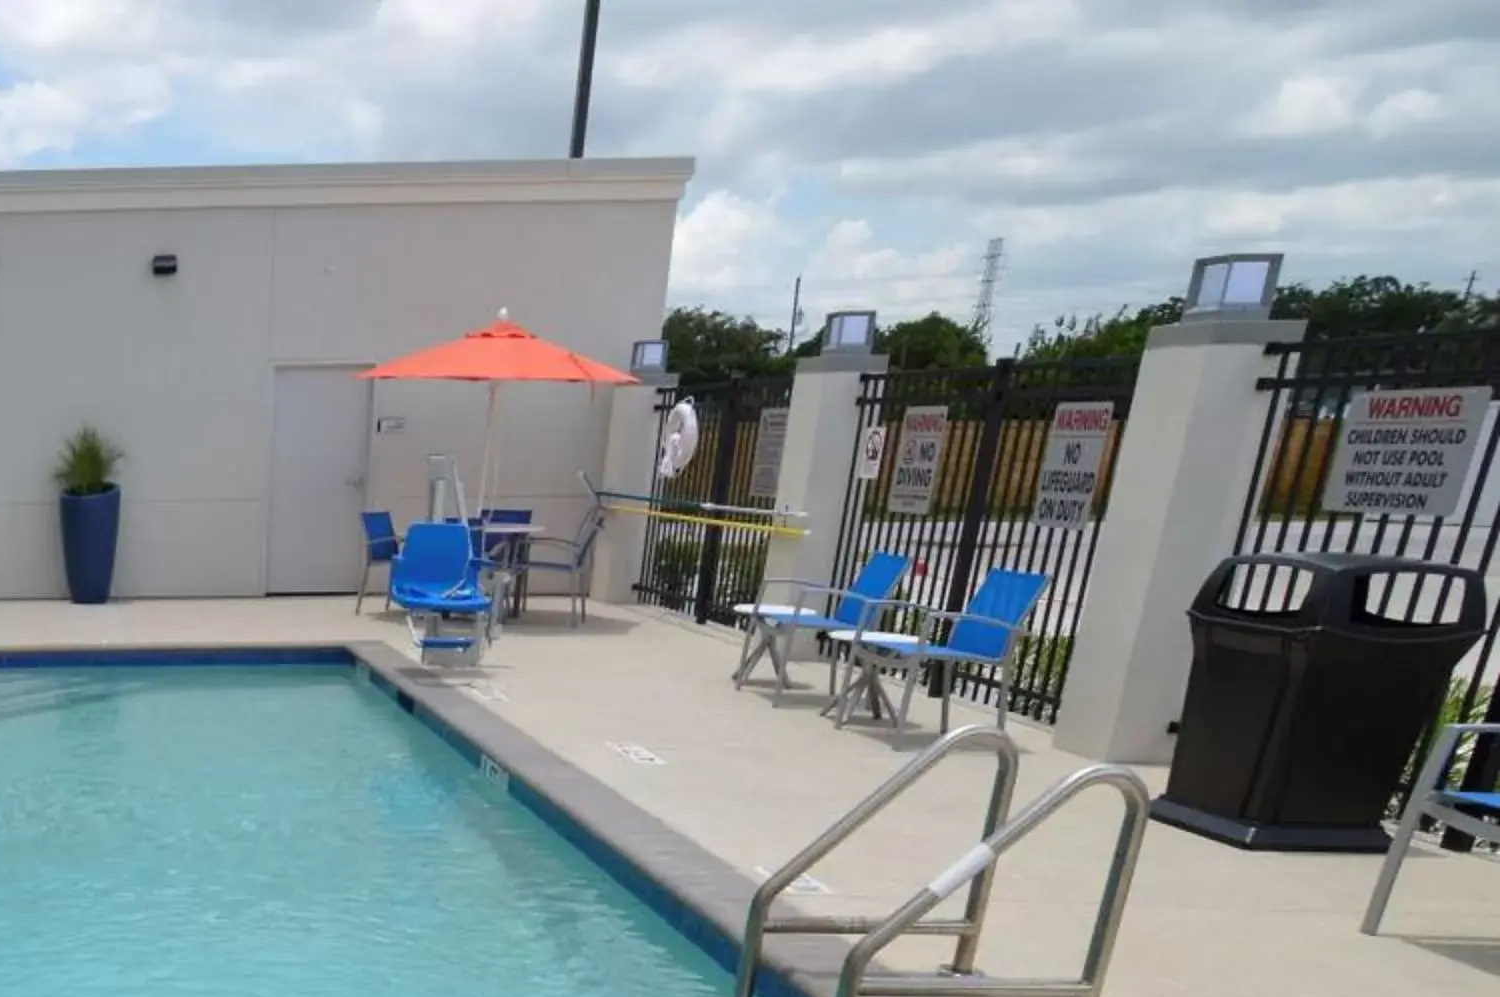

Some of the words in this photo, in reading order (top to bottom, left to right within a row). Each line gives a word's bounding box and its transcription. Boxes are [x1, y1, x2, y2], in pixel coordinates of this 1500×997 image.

[1368, 395, 1464, 420] WARNING
[1055, 408, 1110, 432] WARNING
[1347, 430, 1407, 445] CHILDREN
[1409, 429, 1467, 445] SHOULD
[920, 441, 936, 462] NO
[1063, 442, 1082, 464] NO
[1352, 451, 1381, 465] NOT
[1382, 451, 1407, 466] USE
[1408, 451, 1444, 466] POOL
[896, 467, 933, 487] DIVING
[1041, 470, 1095, 493] LIFEGUARD
[1345, 472, 1402, 487] WITHOUT
[1403, 472, 1449, 488] ADULT
[1038, 497, 1055, 518] ON
[1055, 499, 1086, 522] DUTY
[1344, 491, 1429, 509] SUPERVISION
